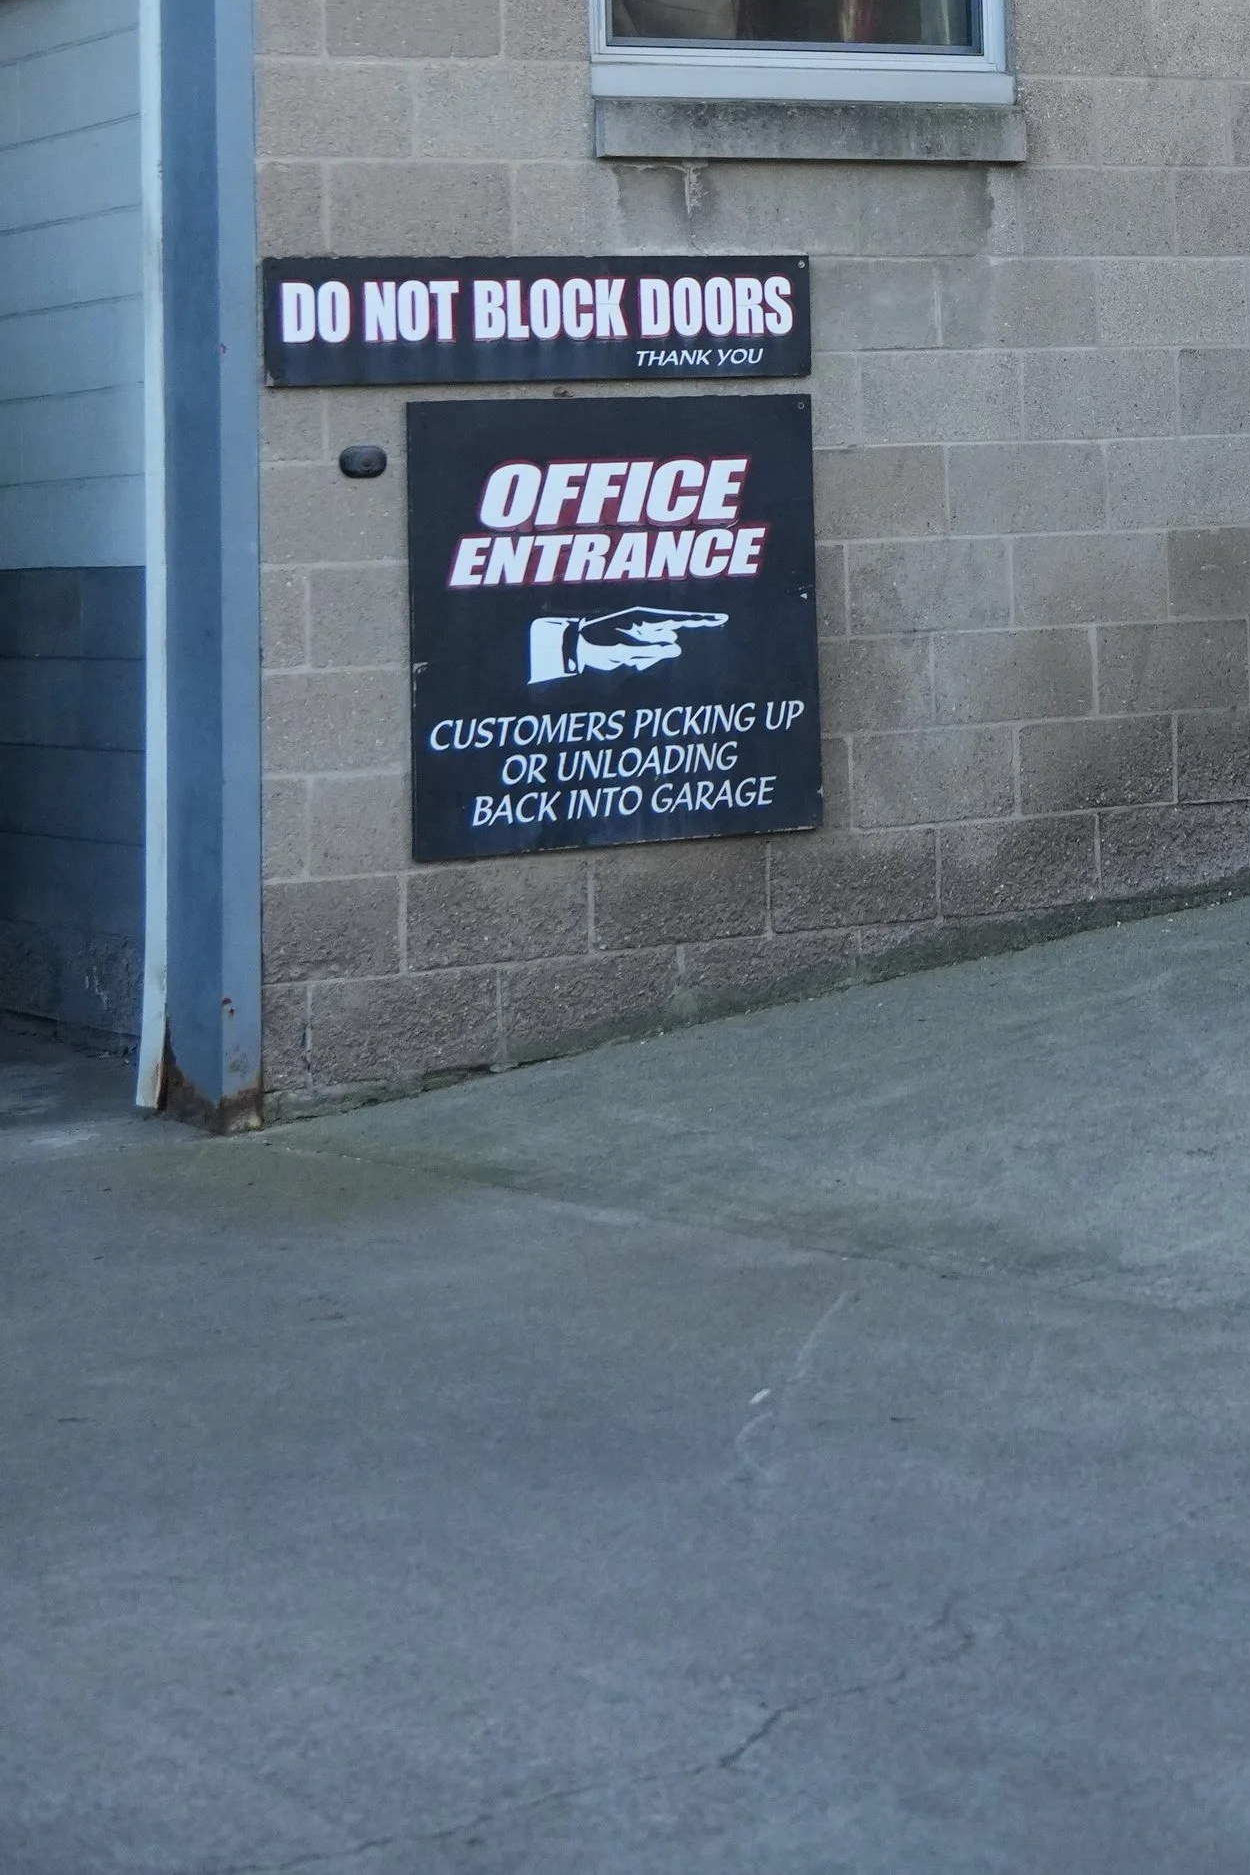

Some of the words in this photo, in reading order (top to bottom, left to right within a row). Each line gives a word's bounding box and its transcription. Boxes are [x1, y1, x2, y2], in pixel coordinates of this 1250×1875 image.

[281, 281, 351, 343] DO
[363, 280, 460, 342] NOT
[473, 278, 629, 340] BLOCK
[639, 276, 794, 337] DOORS
[636, 349, 712, 368] THANK
[717, 348, 764, 366] YOU
[479, 458, 749, 528] OFFICE
[447, 527, 766, 587] ENTRANCE
[429, 710, 625, 752] CUSTOMERS
[633, 702, 757, 741] PICKING
[765, 699, 805, 731] UP
[501, 753, 549, 786] OR
[557, 741, 739, 781] UNLOADING
[471, 790, 562, 827] BACK
[567, 785, 643, 819] INTO
[650, 775, 778, 814] GARAGE
